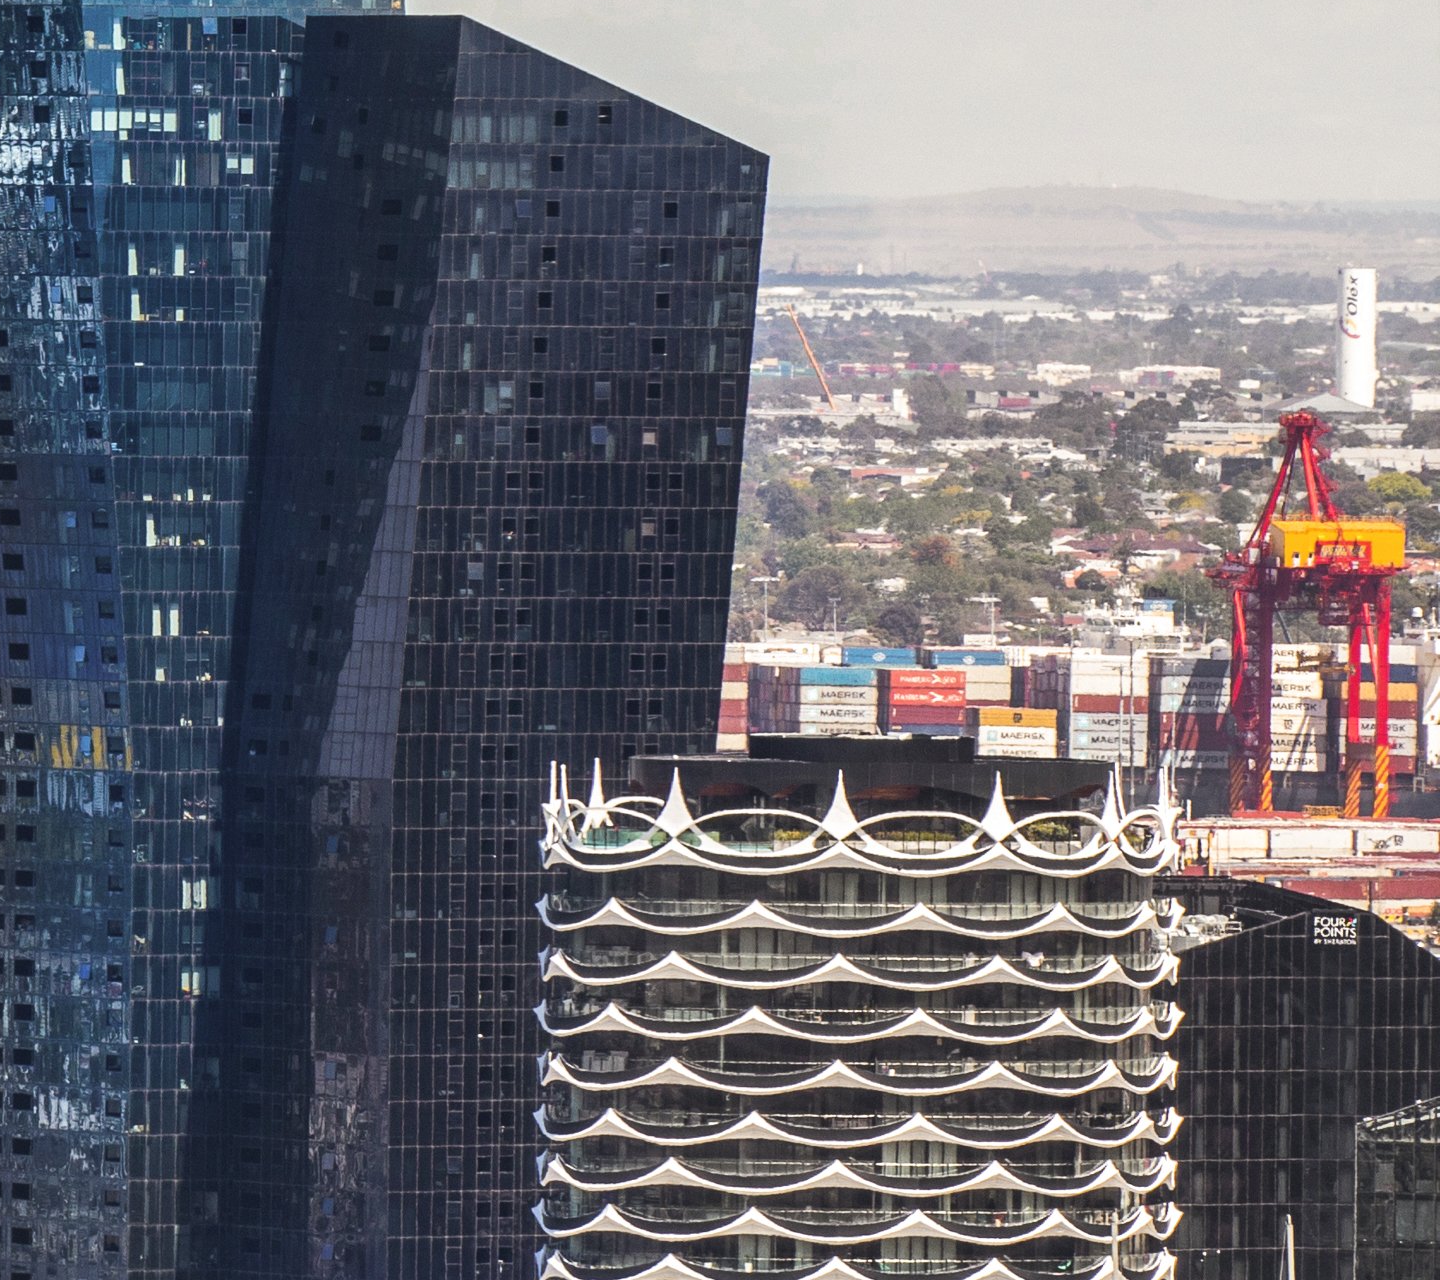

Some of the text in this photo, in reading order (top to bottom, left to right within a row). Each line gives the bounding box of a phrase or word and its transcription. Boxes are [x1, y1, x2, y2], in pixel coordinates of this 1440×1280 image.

[820, 709, 866, 718] MAERSK
[1000, 731, 1046, 740] MAERSK
[1314, 916, 1346, 927] FOUR
[1314, 927, 1357, 938] POINTS
